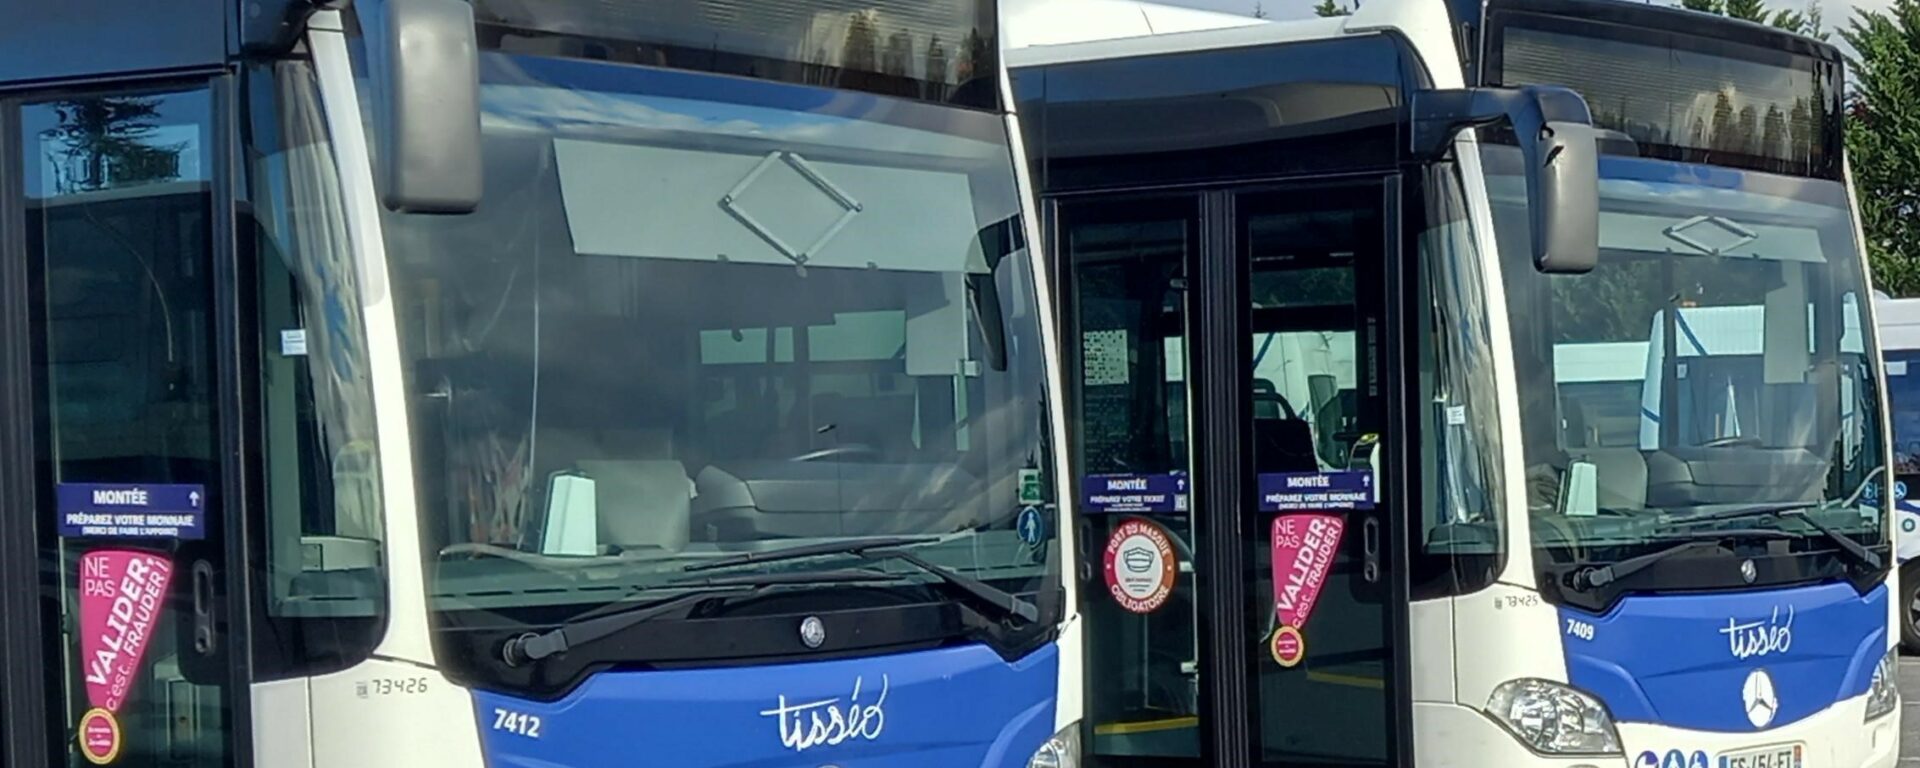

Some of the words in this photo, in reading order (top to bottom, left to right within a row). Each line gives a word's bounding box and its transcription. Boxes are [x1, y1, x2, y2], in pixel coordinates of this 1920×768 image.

[1106, 477, 1147, 490] MONTÉE
[1286, 475, 1330, 488] MONTÉE
[93, 488, 148, 505] MONTÉE
[66, 511, 113, 525] PRÉPAREZ
[115, 514, 145, 526] VOTRE
[146, 515, 195, 527] MONNAIE
[1275, 519, 1296, 535] NE
[1107, 524, 1126, 554] PORT
[1140, 524, 1171, 558] MASQUE
[1276, 535, 1300, 549] PAS
[84, 557, 110, 578] NE
[84, 579, 116, 598] PAS
[1111, 584, 1169, 612] OBLIGATOIRE
[1566, 618, 1594, 641] 7409
[1719, 604, 1794, 660] tisséo
[372, 677, 428, 695] 73426
[760, 673, 888, 752] tisséo
[493, 708, 541, 738] 7412
